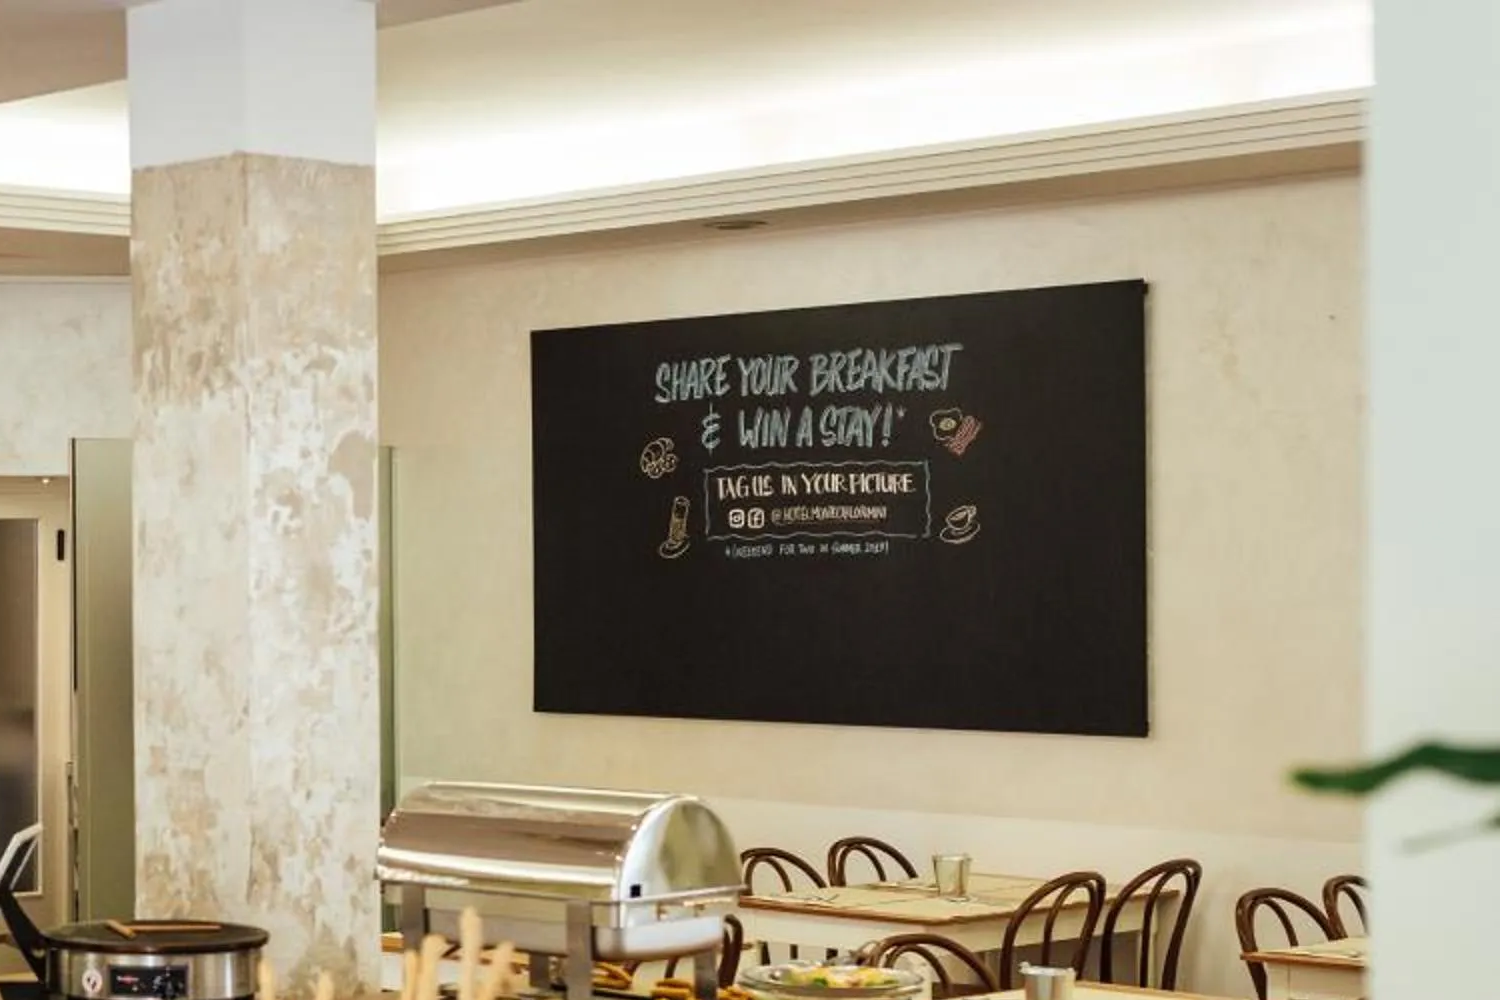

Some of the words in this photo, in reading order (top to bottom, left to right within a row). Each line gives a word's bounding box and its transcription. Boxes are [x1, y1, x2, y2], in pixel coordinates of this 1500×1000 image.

[654, 354, 731, 403] SHARE
[737, 354, 799, 397] YOUR
[809, 343, 964, 397] BREAKFAST
[701, 402, 721, 457] &
[739, 406, 791, 449] WIN
[796, 405, 813, 448] A
[717, 475, 749, 500] TAG
[752, 474, 775, 497] US
[781, 474, 797, 496] IN
[801, 472, 848, 495] YOUR
[848, 472, 916, 495] PICTURE
